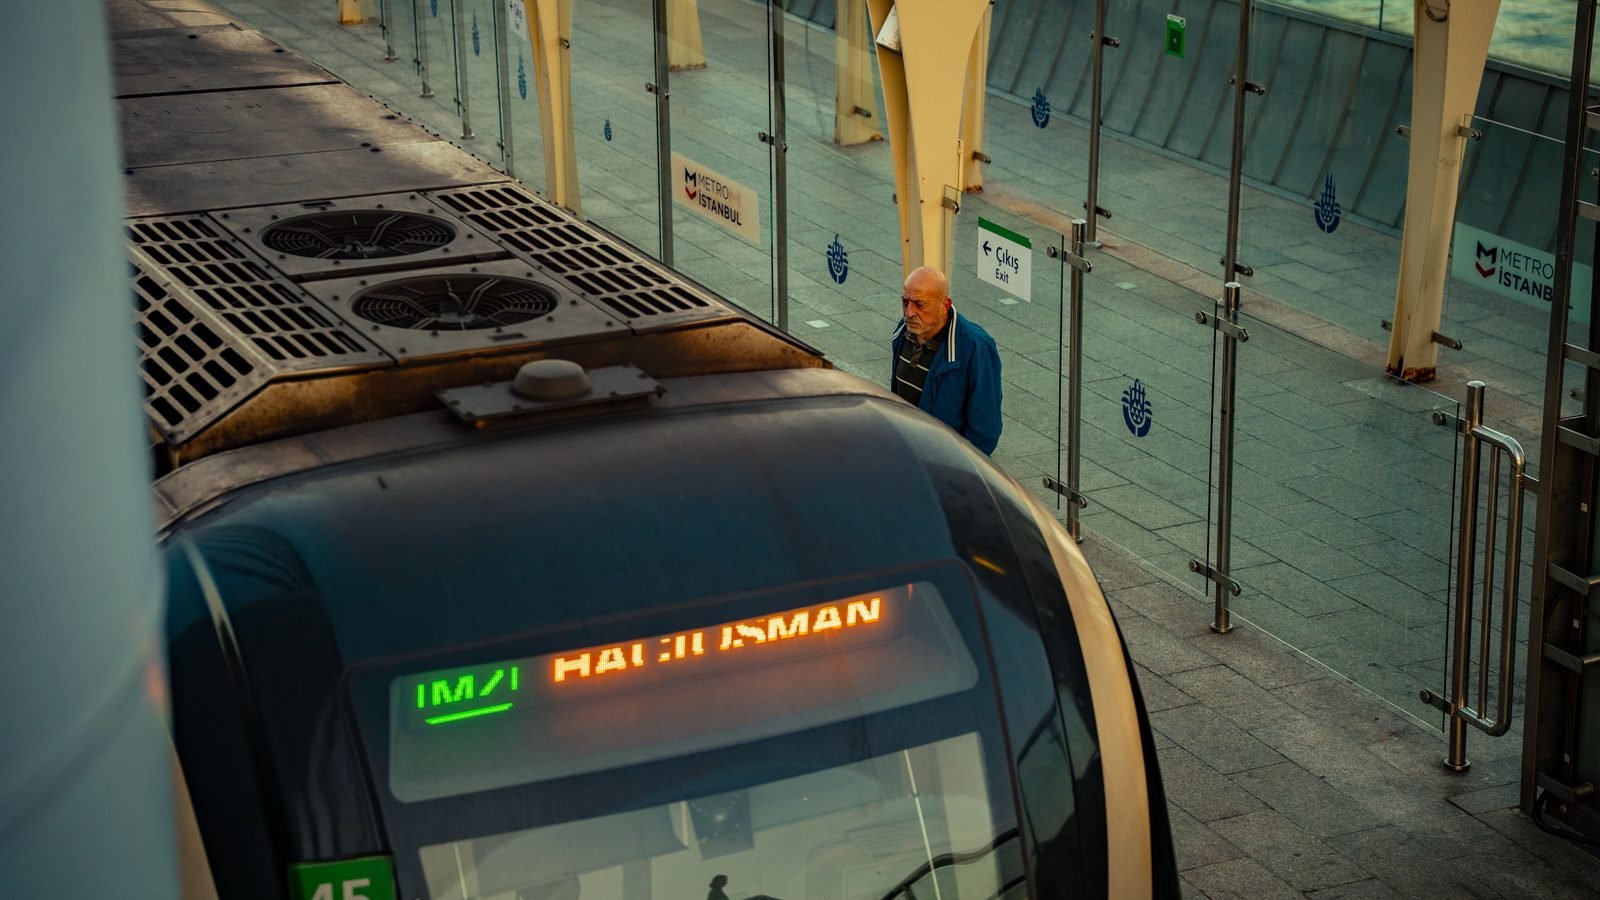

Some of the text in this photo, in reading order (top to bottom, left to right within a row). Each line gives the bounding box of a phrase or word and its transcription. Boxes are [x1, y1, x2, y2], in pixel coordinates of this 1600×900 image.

[698, 173, 729, 200] METRO
[698, 189, 741, 226] İSTANBUL
[995, 246, 1019, 274] Çıkış
[1500, 247, 1554, 280] METRO
[995, 268, 1009, 284] Exit
[1498, 266, 1573, 310] İSTANB
